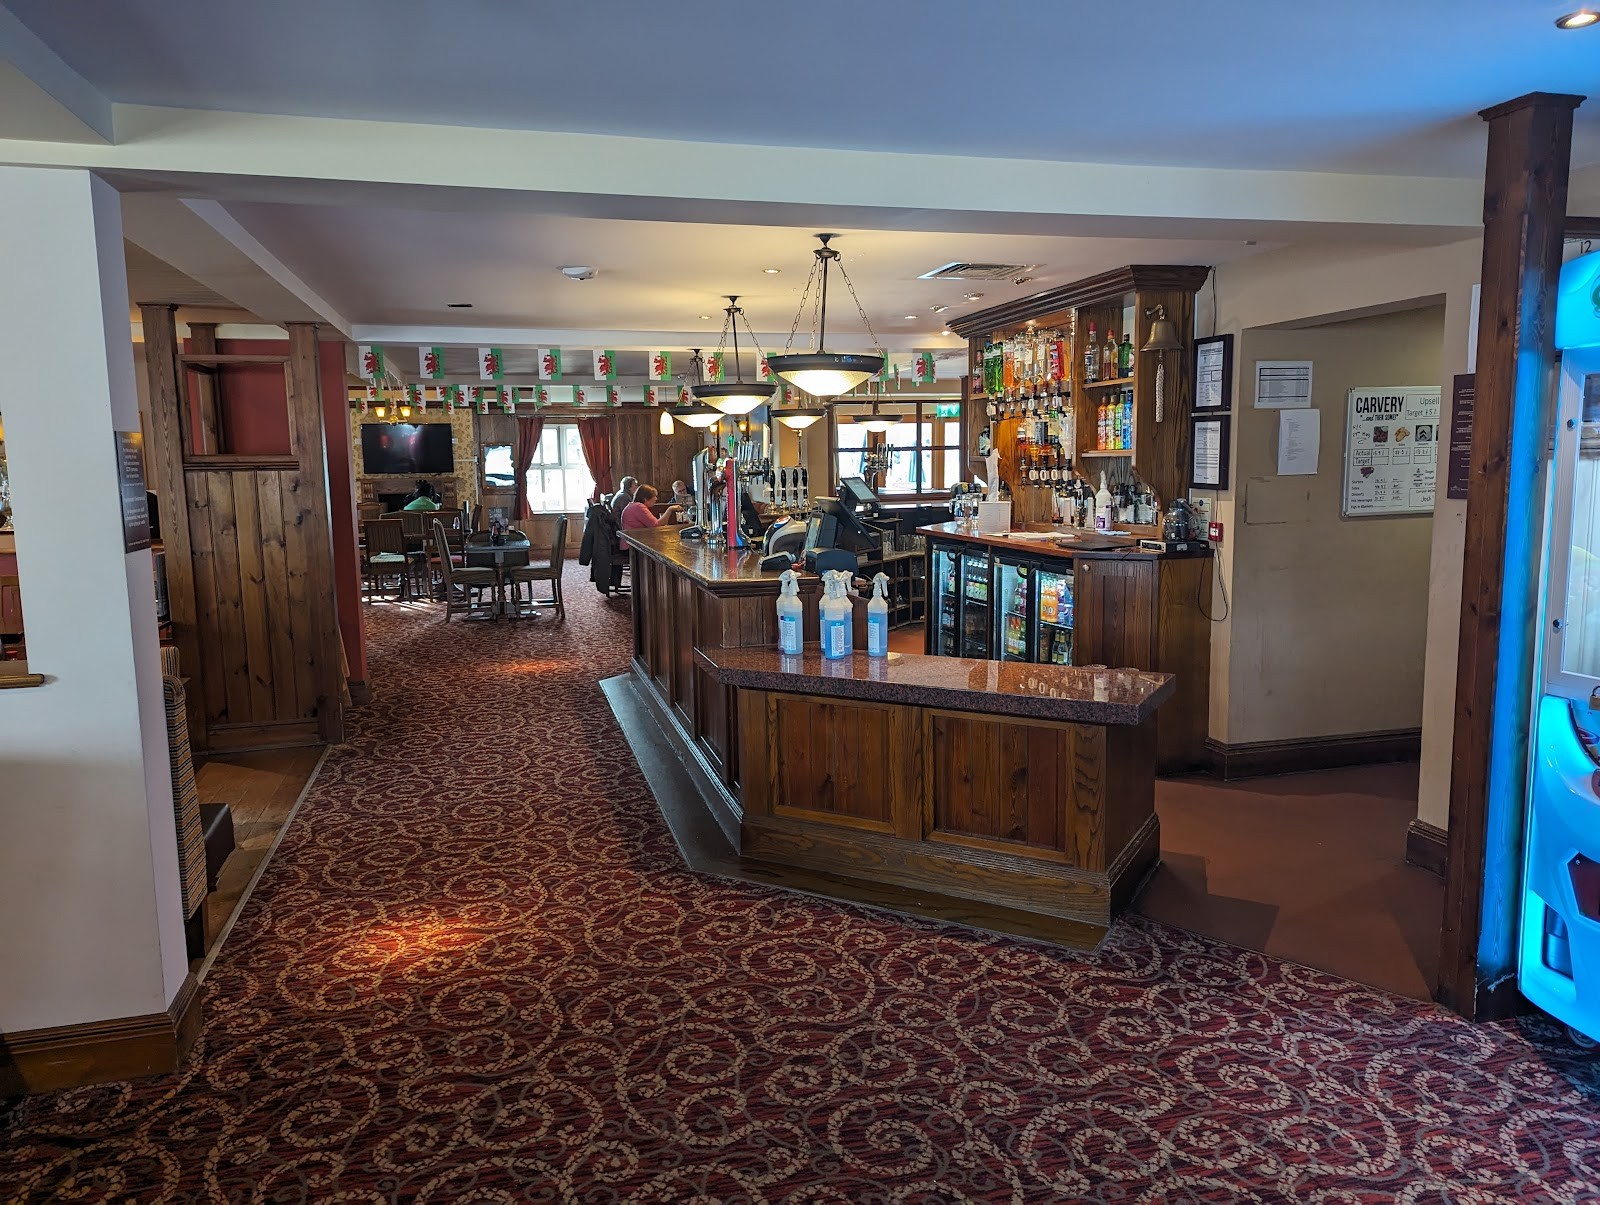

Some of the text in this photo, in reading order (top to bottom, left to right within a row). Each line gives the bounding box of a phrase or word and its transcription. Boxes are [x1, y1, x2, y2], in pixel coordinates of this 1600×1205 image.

[1580, 240, 1592, 254] 12
[1356, 396, 1404, 413] CARVERY
[1420, 397, 1440, 406] Upsell
[1407, 409, 1423, 418] Target
